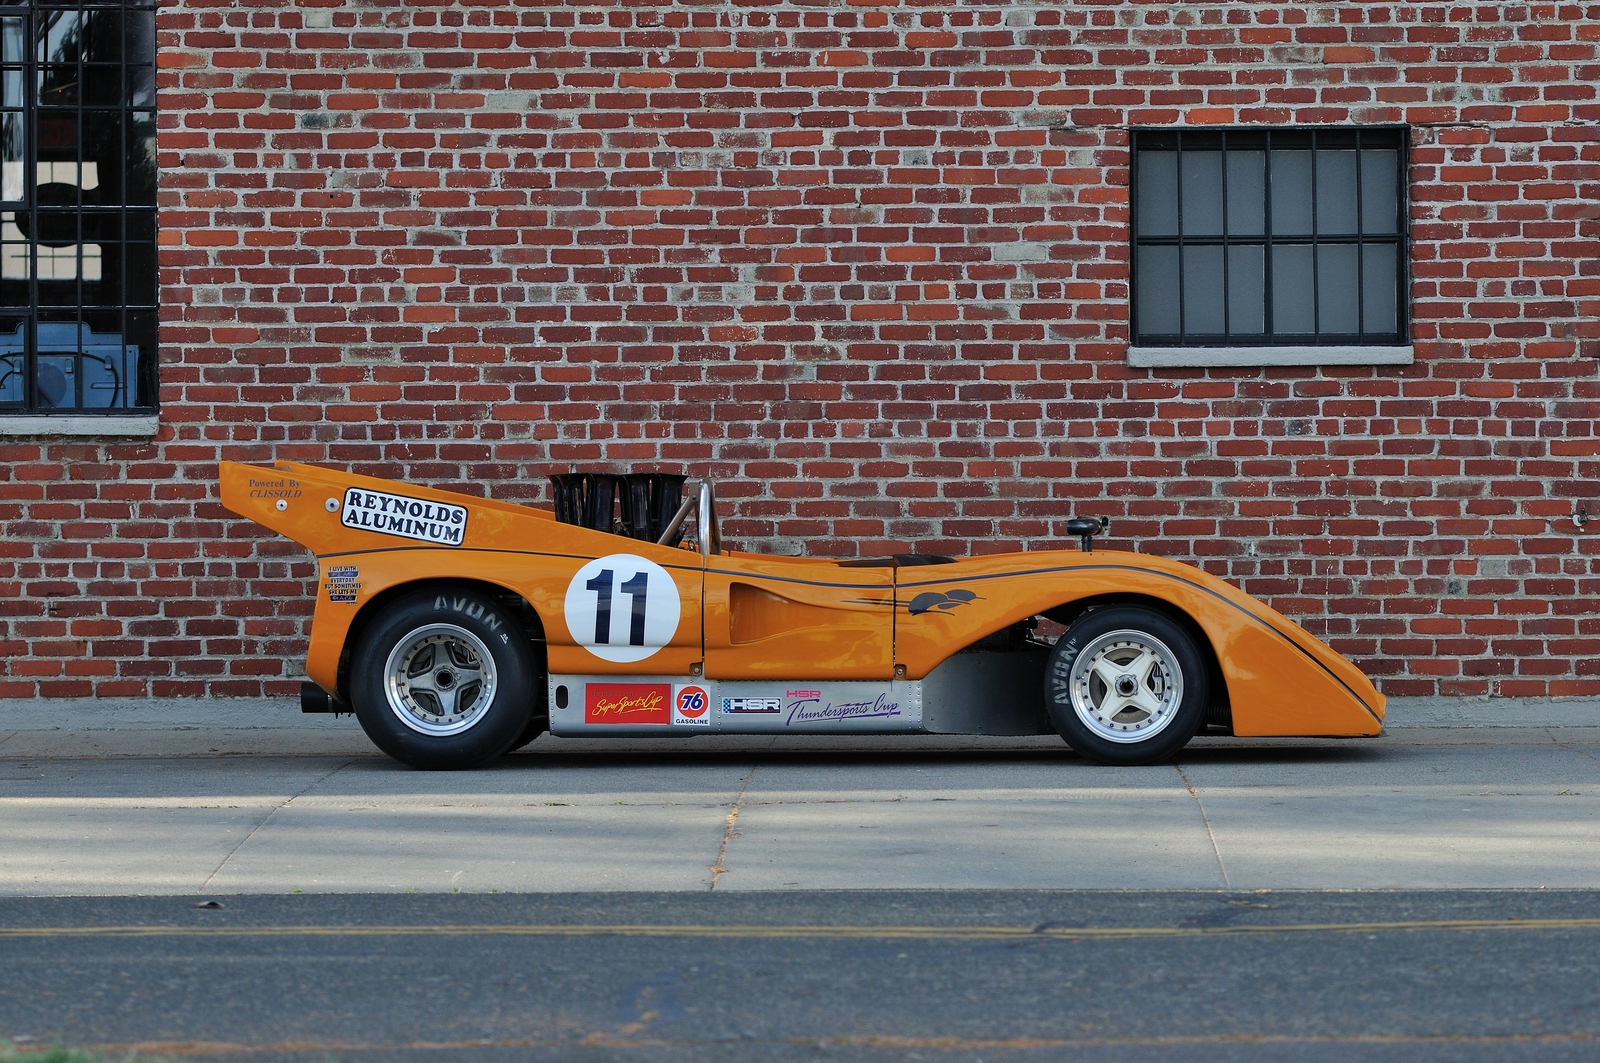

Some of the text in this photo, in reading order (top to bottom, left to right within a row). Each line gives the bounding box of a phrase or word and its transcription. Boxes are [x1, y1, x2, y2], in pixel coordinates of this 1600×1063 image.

[249, 479, 301, 489] Powered By
[249, 489, 302, 498] CLISSOLD
[348, 491, 463, 525] REYNOLDS
[345, 509, 461, 542] ALUMINUM
[433, 596, 502, 632] AVON
[586, 569, 648, 646] 11
[1053, 644, 1079, 705] AVON
[680, 692, 704, 711] 76
[730, 699, 780, 710] HSR
[786, 690, 821, 698] HSR
[786, 692, 899, 726] Thundersports Cup
